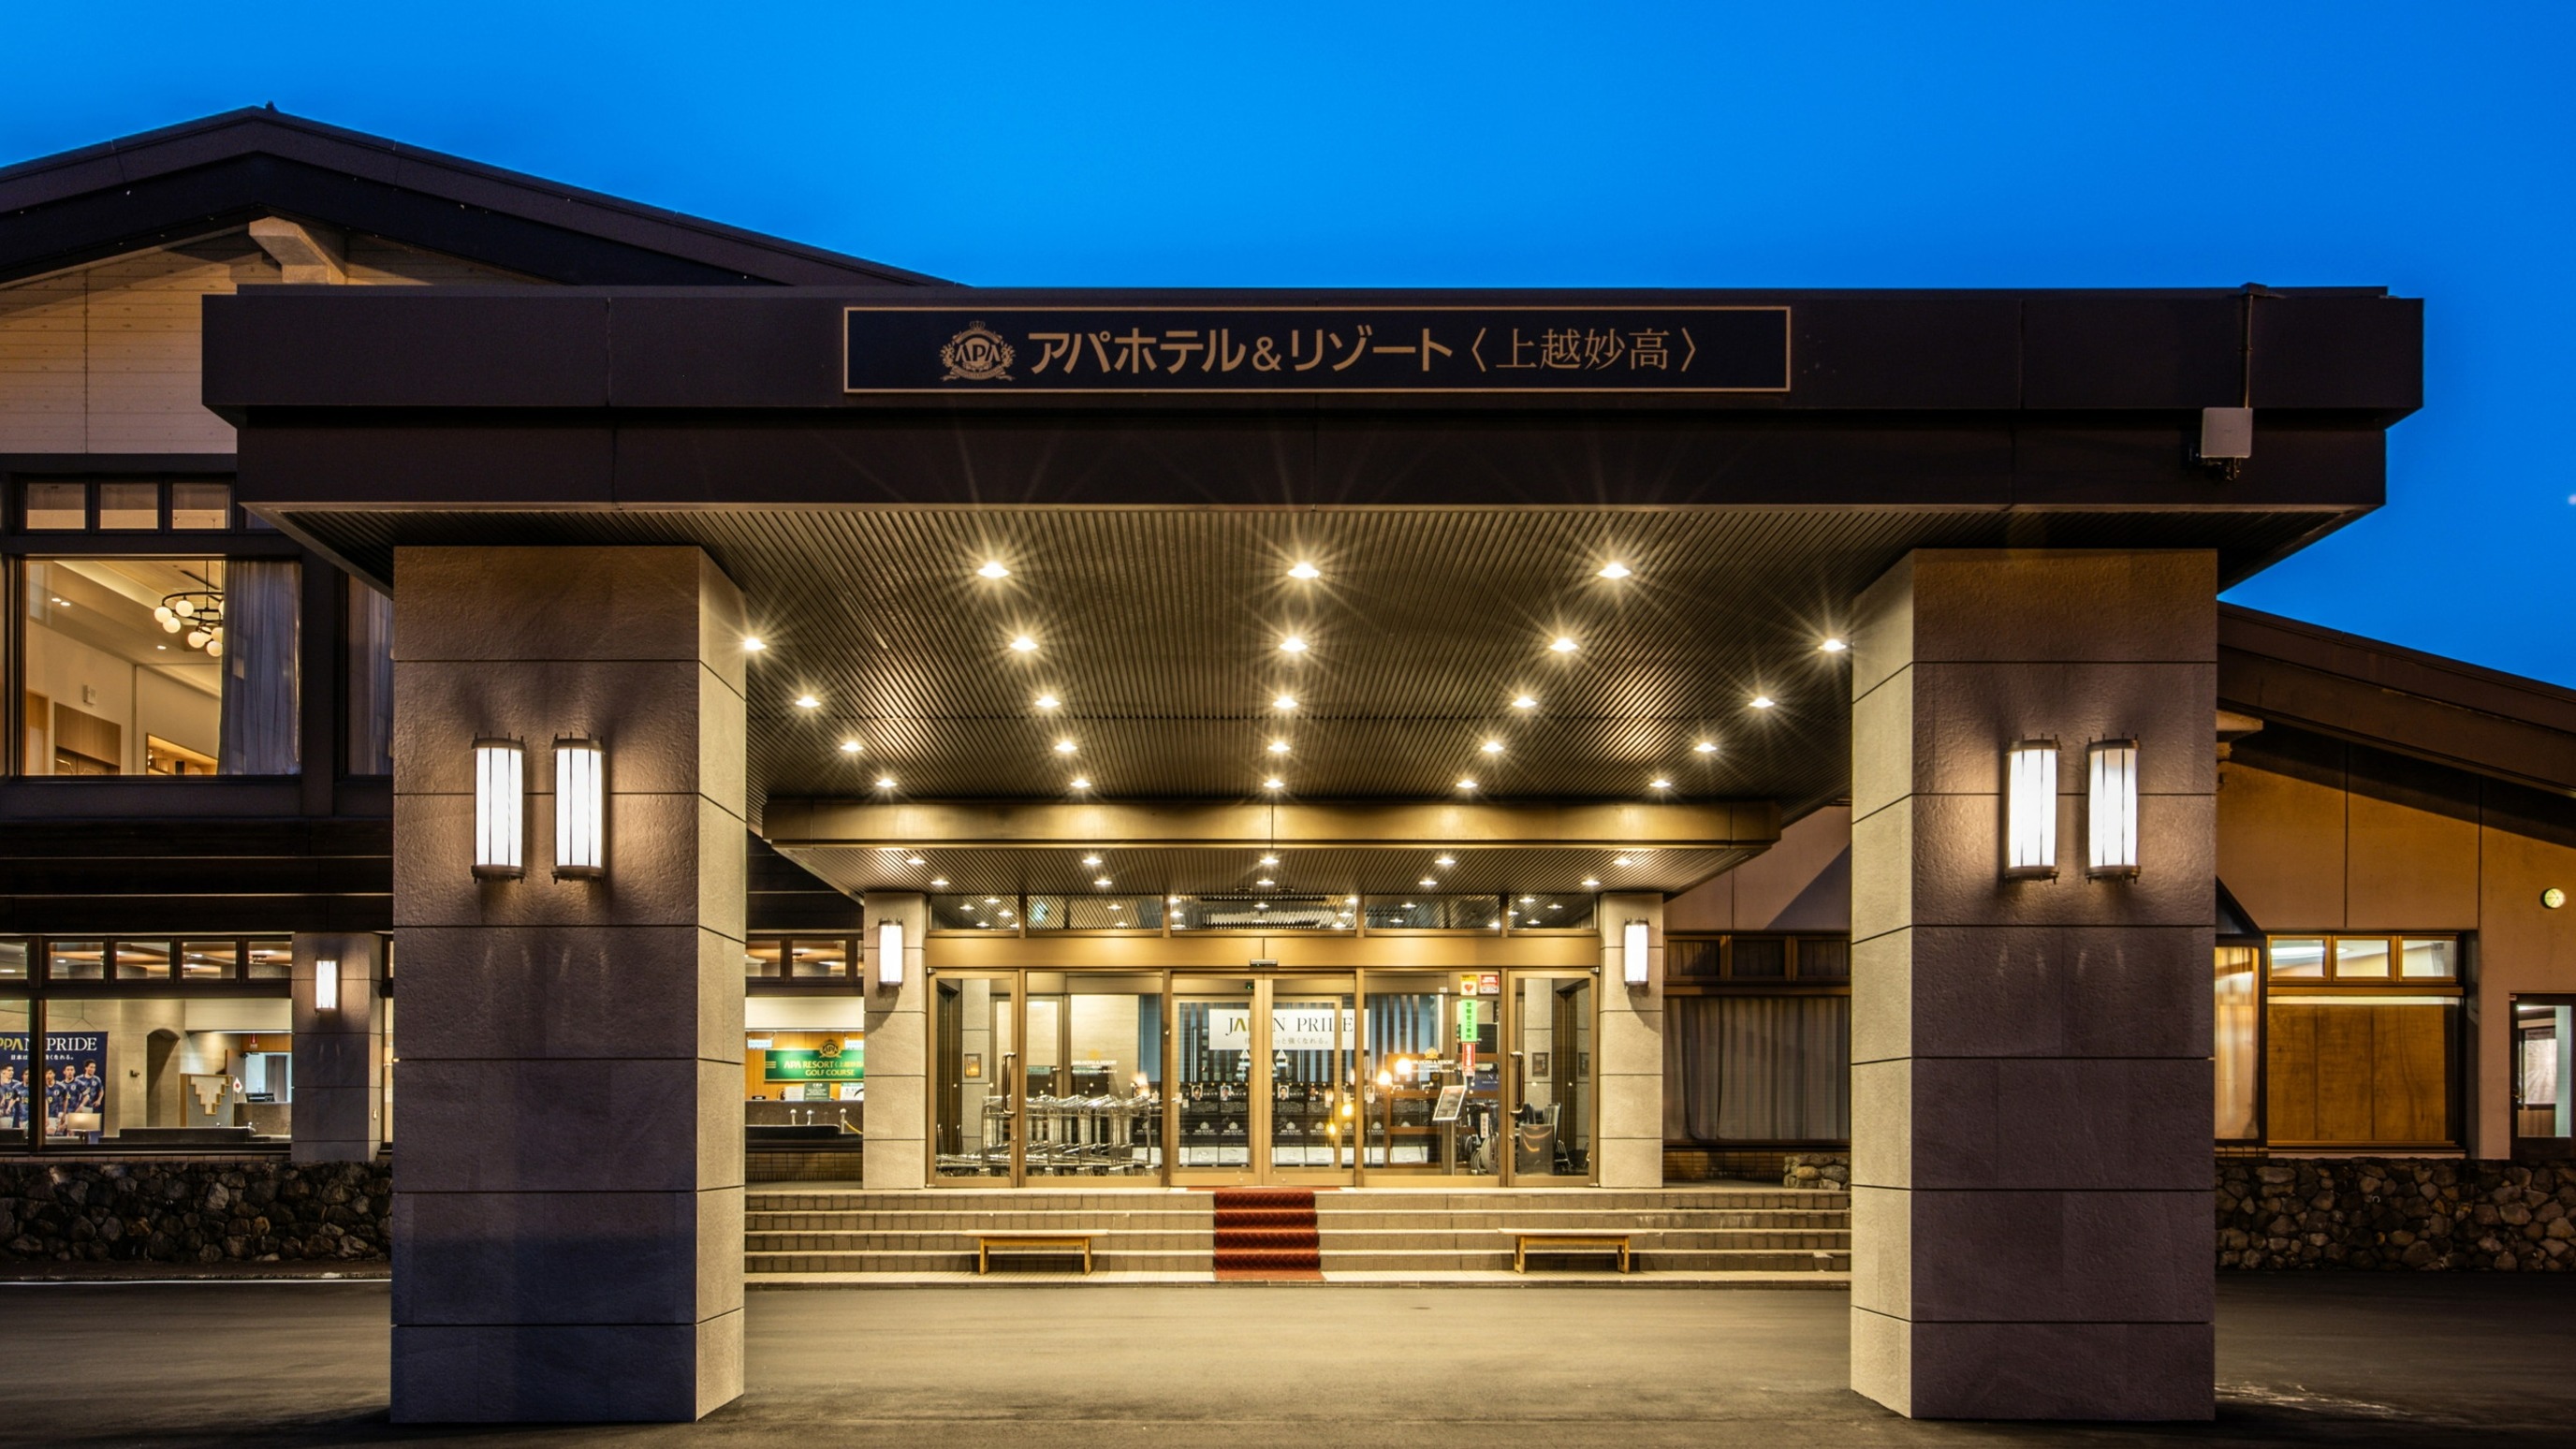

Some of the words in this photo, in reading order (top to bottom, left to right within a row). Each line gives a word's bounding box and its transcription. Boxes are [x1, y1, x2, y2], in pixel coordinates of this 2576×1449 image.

[955, 344, 1001, 362] APA
[1225, 1017, 1285, 1036] JAN
[46, 1037, 97, 1051] PRIDE
[783, 1061, 802, 1069] APA
[802, 1061, 834, 1069] RESORT
